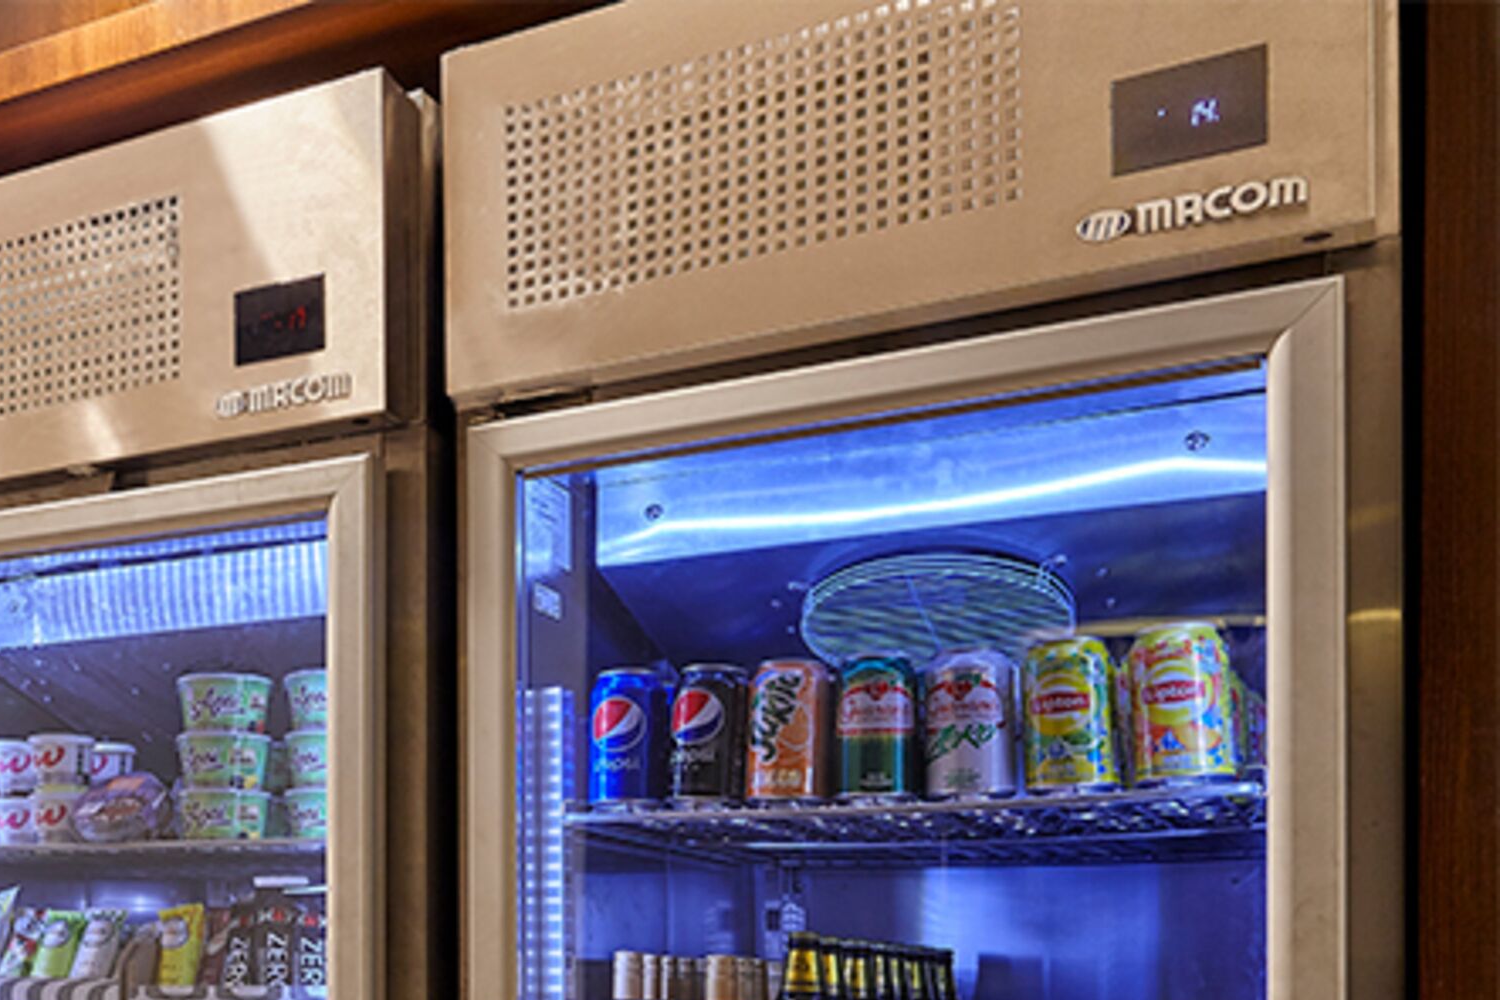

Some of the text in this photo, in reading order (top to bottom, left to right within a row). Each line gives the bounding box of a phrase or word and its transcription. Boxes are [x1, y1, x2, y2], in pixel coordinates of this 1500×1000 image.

[226, 937, 251, 986] ZER
[266, 932, 288, 986] ZER
[301, 937, 323, 983] ZER
